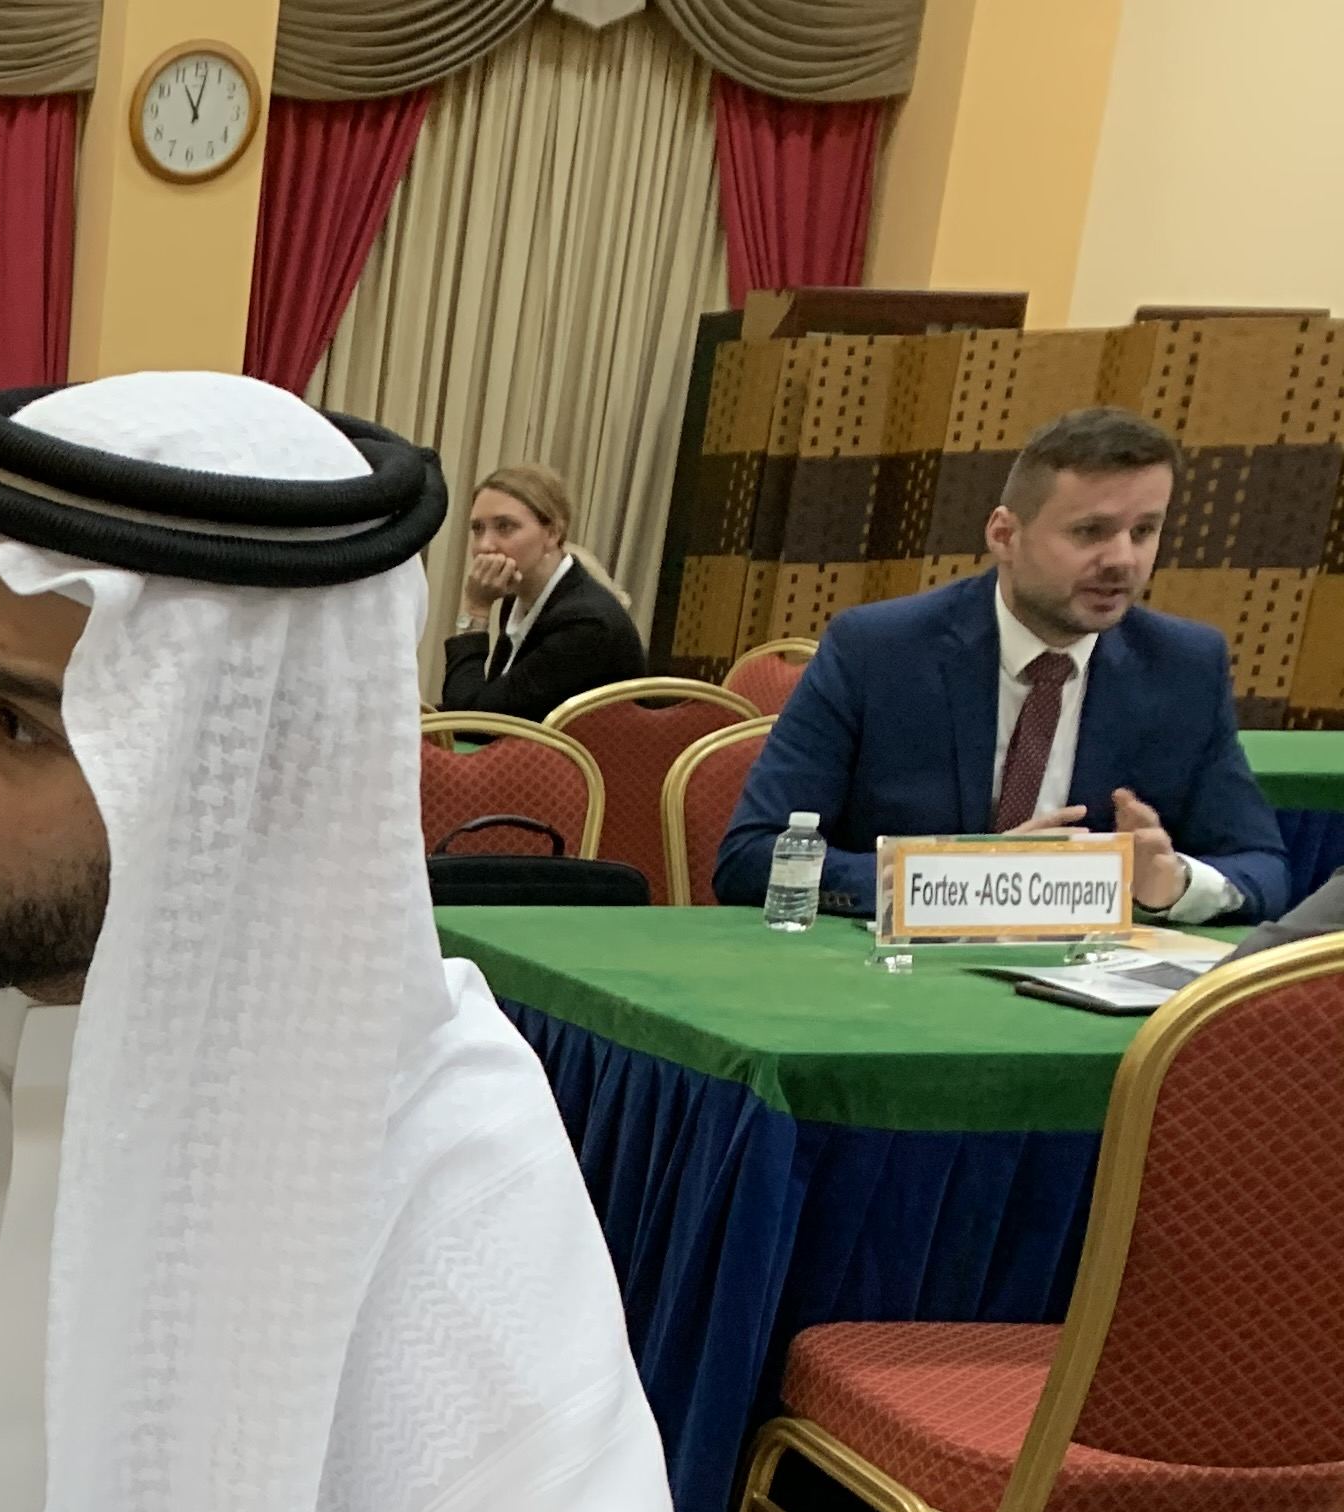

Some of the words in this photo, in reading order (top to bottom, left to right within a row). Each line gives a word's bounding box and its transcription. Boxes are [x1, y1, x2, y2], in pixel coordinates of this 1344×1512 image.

[175, 67, 186, 84] 11
[217, 67, 223, 84] 1
[158, 83, 171, 99] 10
[227, 82, 237, 99] 2
[151, 104, 159, 119] 9
[232, 105, 241, 121] 3
[153, 126, 163, 141] 8
[168, 140, 177, 158] 7
[185, 146, 193, 163] 6
[206, 141, 215, 158] 5
[910, 872, 969, 906] Fortex
[974, 872, 1022, 906] -AGS
[1028, 872, 1117, 914] Company
